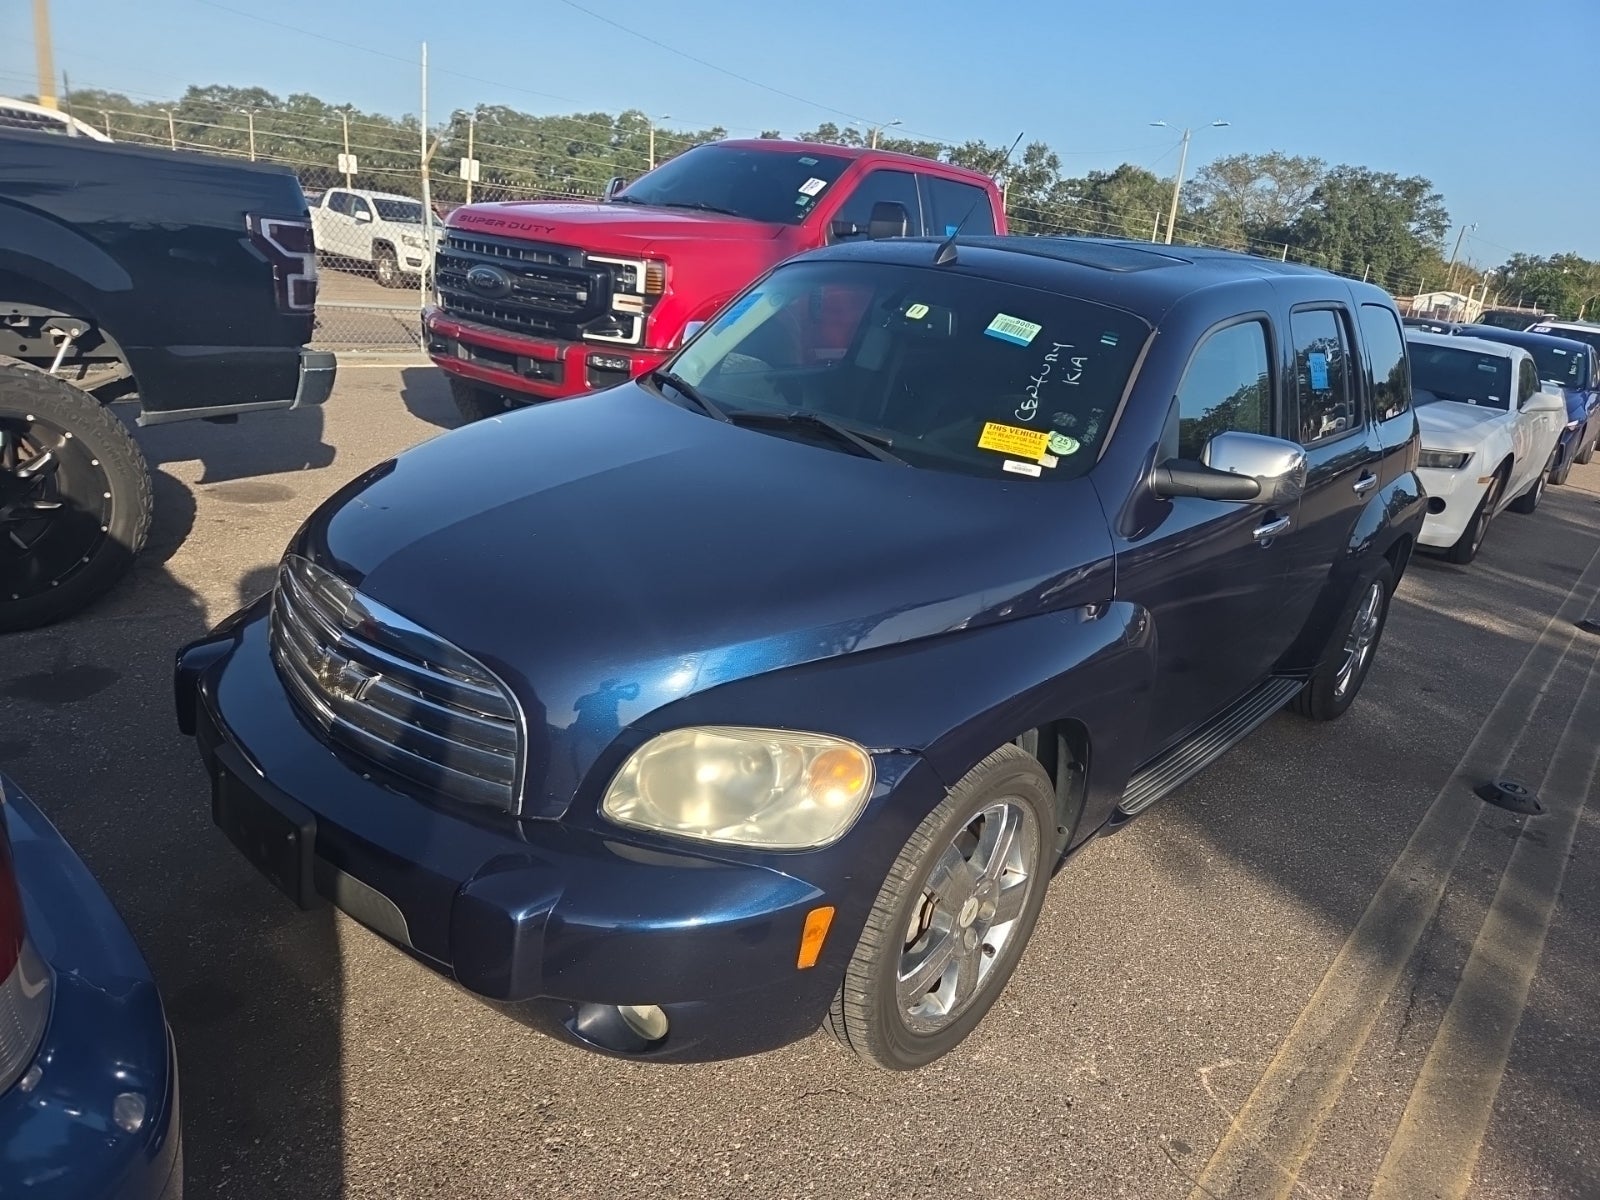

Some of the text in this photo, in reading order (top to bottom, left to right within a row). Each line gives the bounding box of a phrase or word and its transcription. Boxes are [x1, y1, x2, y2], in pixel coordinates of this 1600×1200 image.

[459, 214, 556, 234] SUPER DUTY
[988, 424, 1045, 440] THIS VEHICLE
[997, 432, 1016, 440] READY
[1016, 435, 1028, 443] FOR
[1056, 437, 1069, 446] 25
